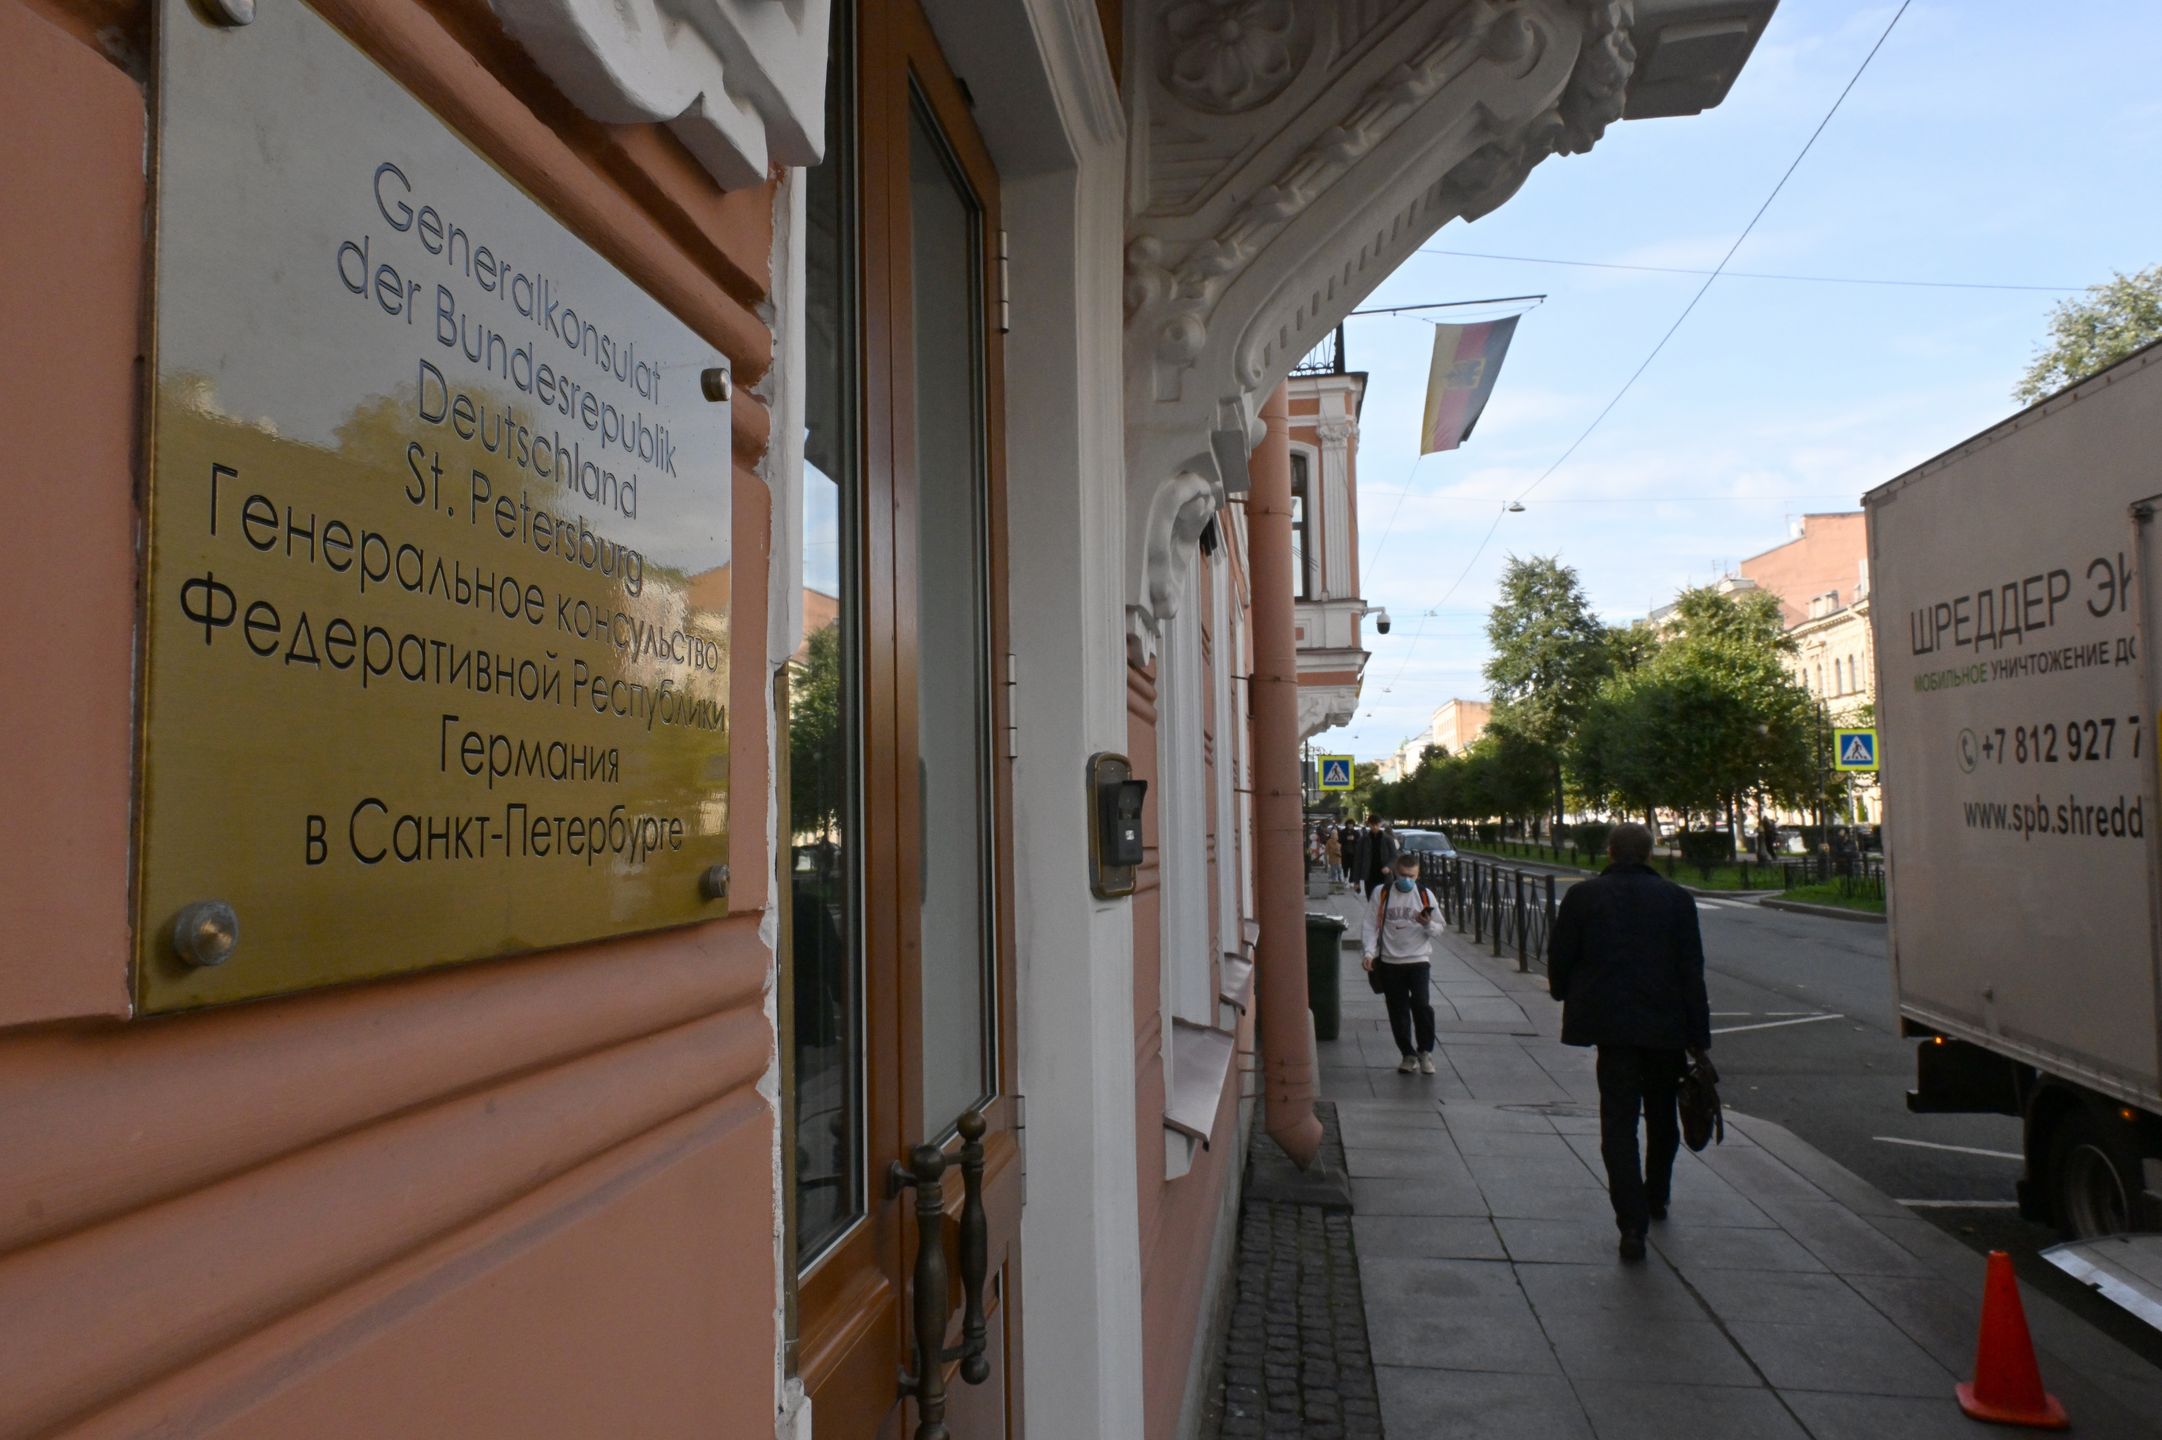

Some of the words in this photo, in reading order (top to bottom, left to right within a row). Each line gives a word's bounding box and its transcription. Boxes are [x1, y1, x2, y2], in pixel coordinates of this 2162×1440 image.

[374, 162, 661, 405] Generalkonsulat
[336, 235, 421, 324] der
[436, 285, 677, 478] Bundesrepublik
[418, 358, 637, 520] Deutschland
[210, 463, 545, 626] Генеральное
[557, 593, 719, 673] консульство
[404, 442, 455, 518] St.
[471, 470, 643, 598] Petersburg
[180, 571, 561, 705] Федеративной
[573, 658, 726, 732] Республики
[1911, 568, 2071, 655] ШРЕДДЕР
[1914, 662, 1988, 693] МОБИЛЬНОЕ
[1991, 641, 2110, 681] УНИЧТОЖЕНИЕ
[441, 714, 619, 789] Германия
[1981, 728, 2005, 764] +7
[2015, 723, 2058, 764] 812
[2066, 718, 2116, 763] 927
[306, 814, 328, 866] в
[349, 798, 683, 867] Санкт-Петербурге
[1963, 794, 2144, 841] www.spb.shredd
